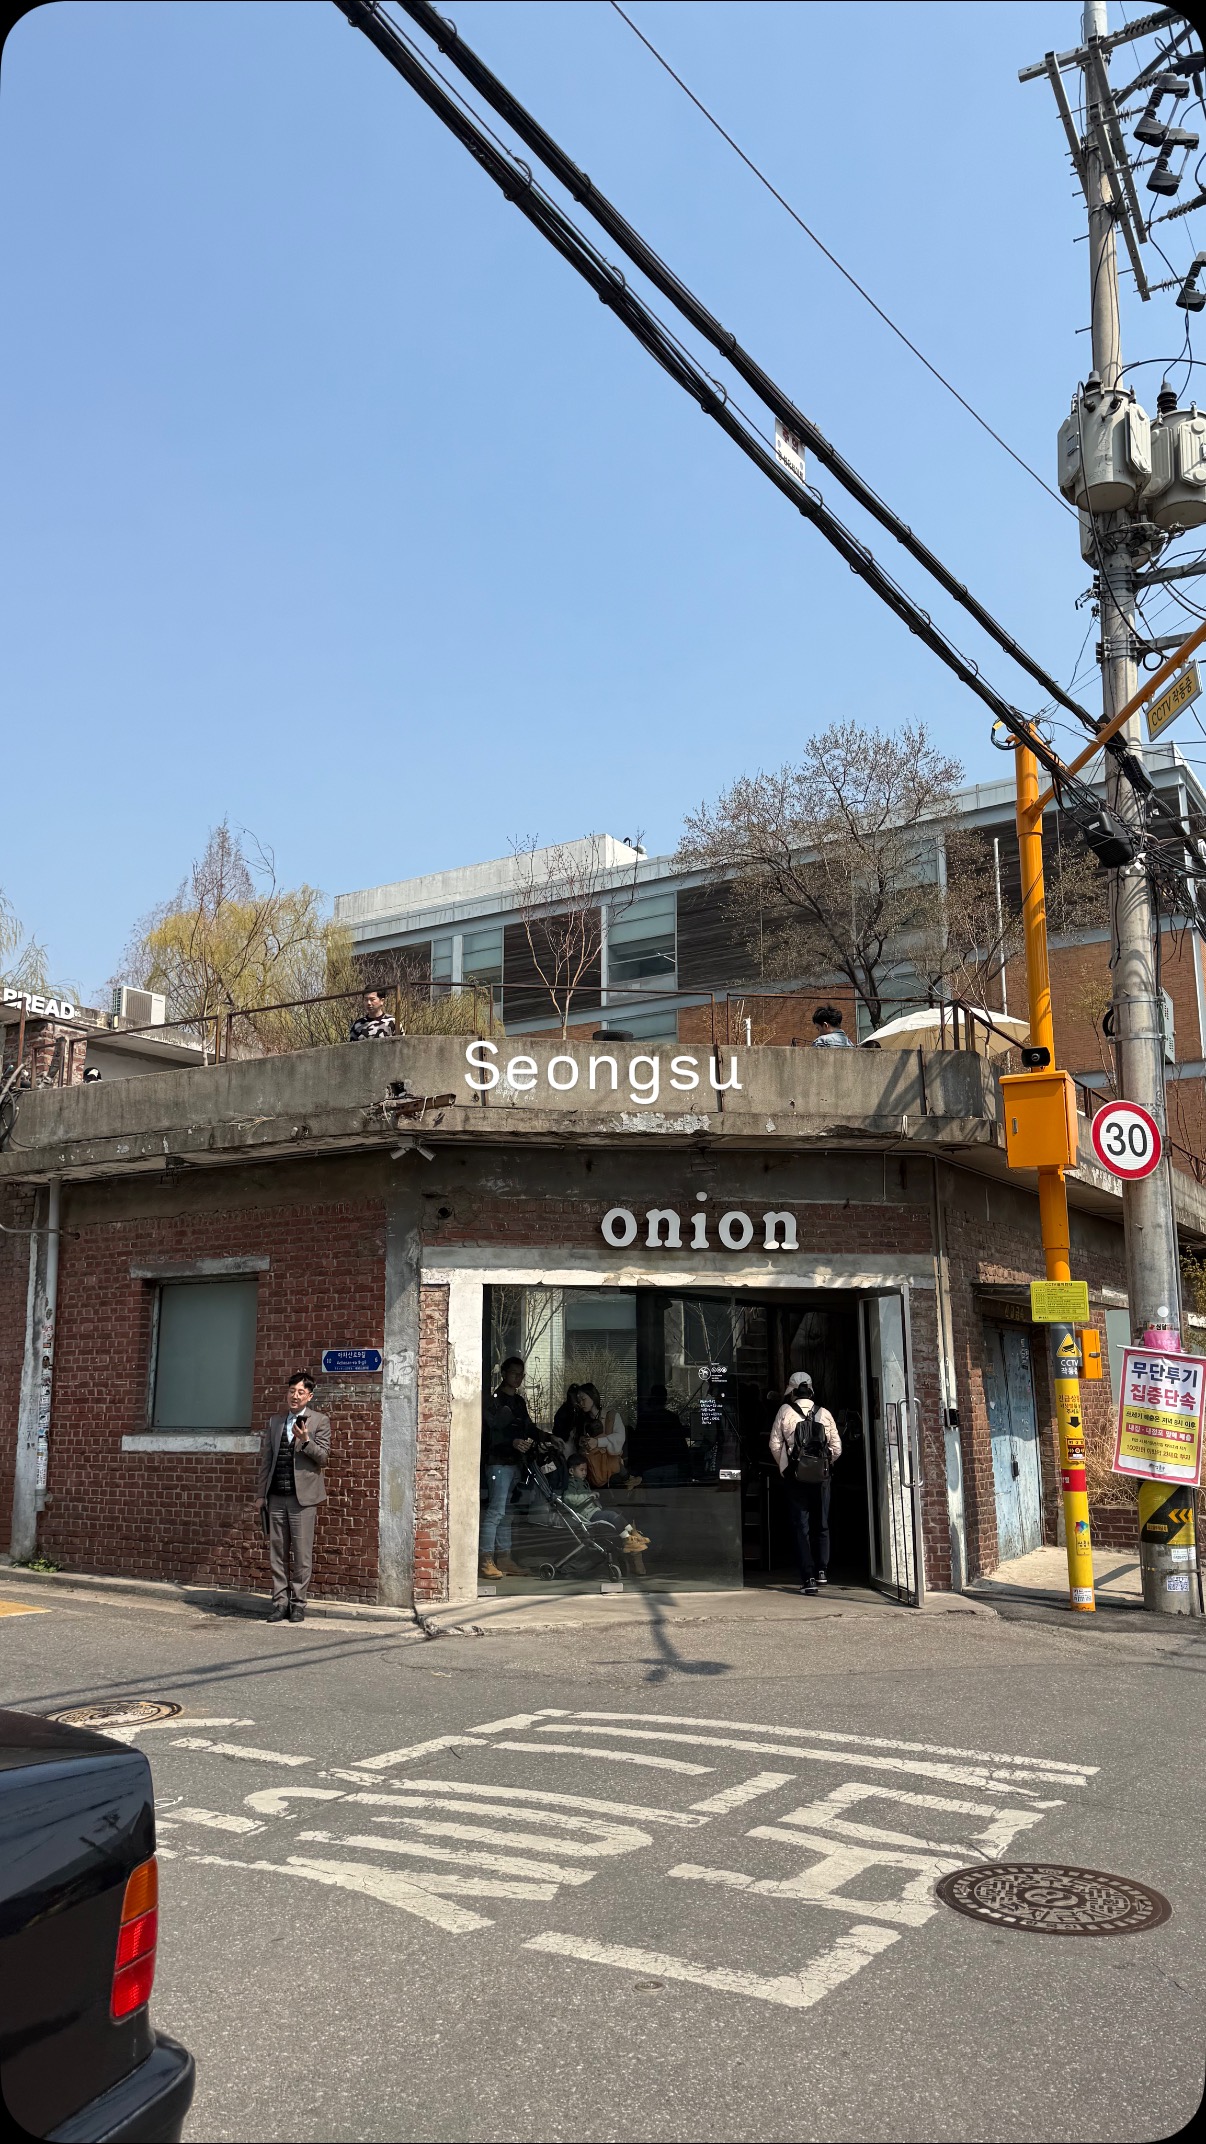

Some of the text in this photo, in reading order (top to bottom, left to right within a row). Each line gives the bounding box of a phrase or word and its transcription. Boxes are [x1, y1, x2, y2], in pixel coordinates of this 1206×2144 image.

[1151, 676, 1193, 727] CCTV 작동중
[3, 987, 75, 1020] BREAD
[1105, 1122, 1148, 1157] 30
[600, 1191, 799, 1250] onion
[1131, 1361, 1198, 1388] 무단투기
[1130, 1383, 1197, 1411] 집중단속
